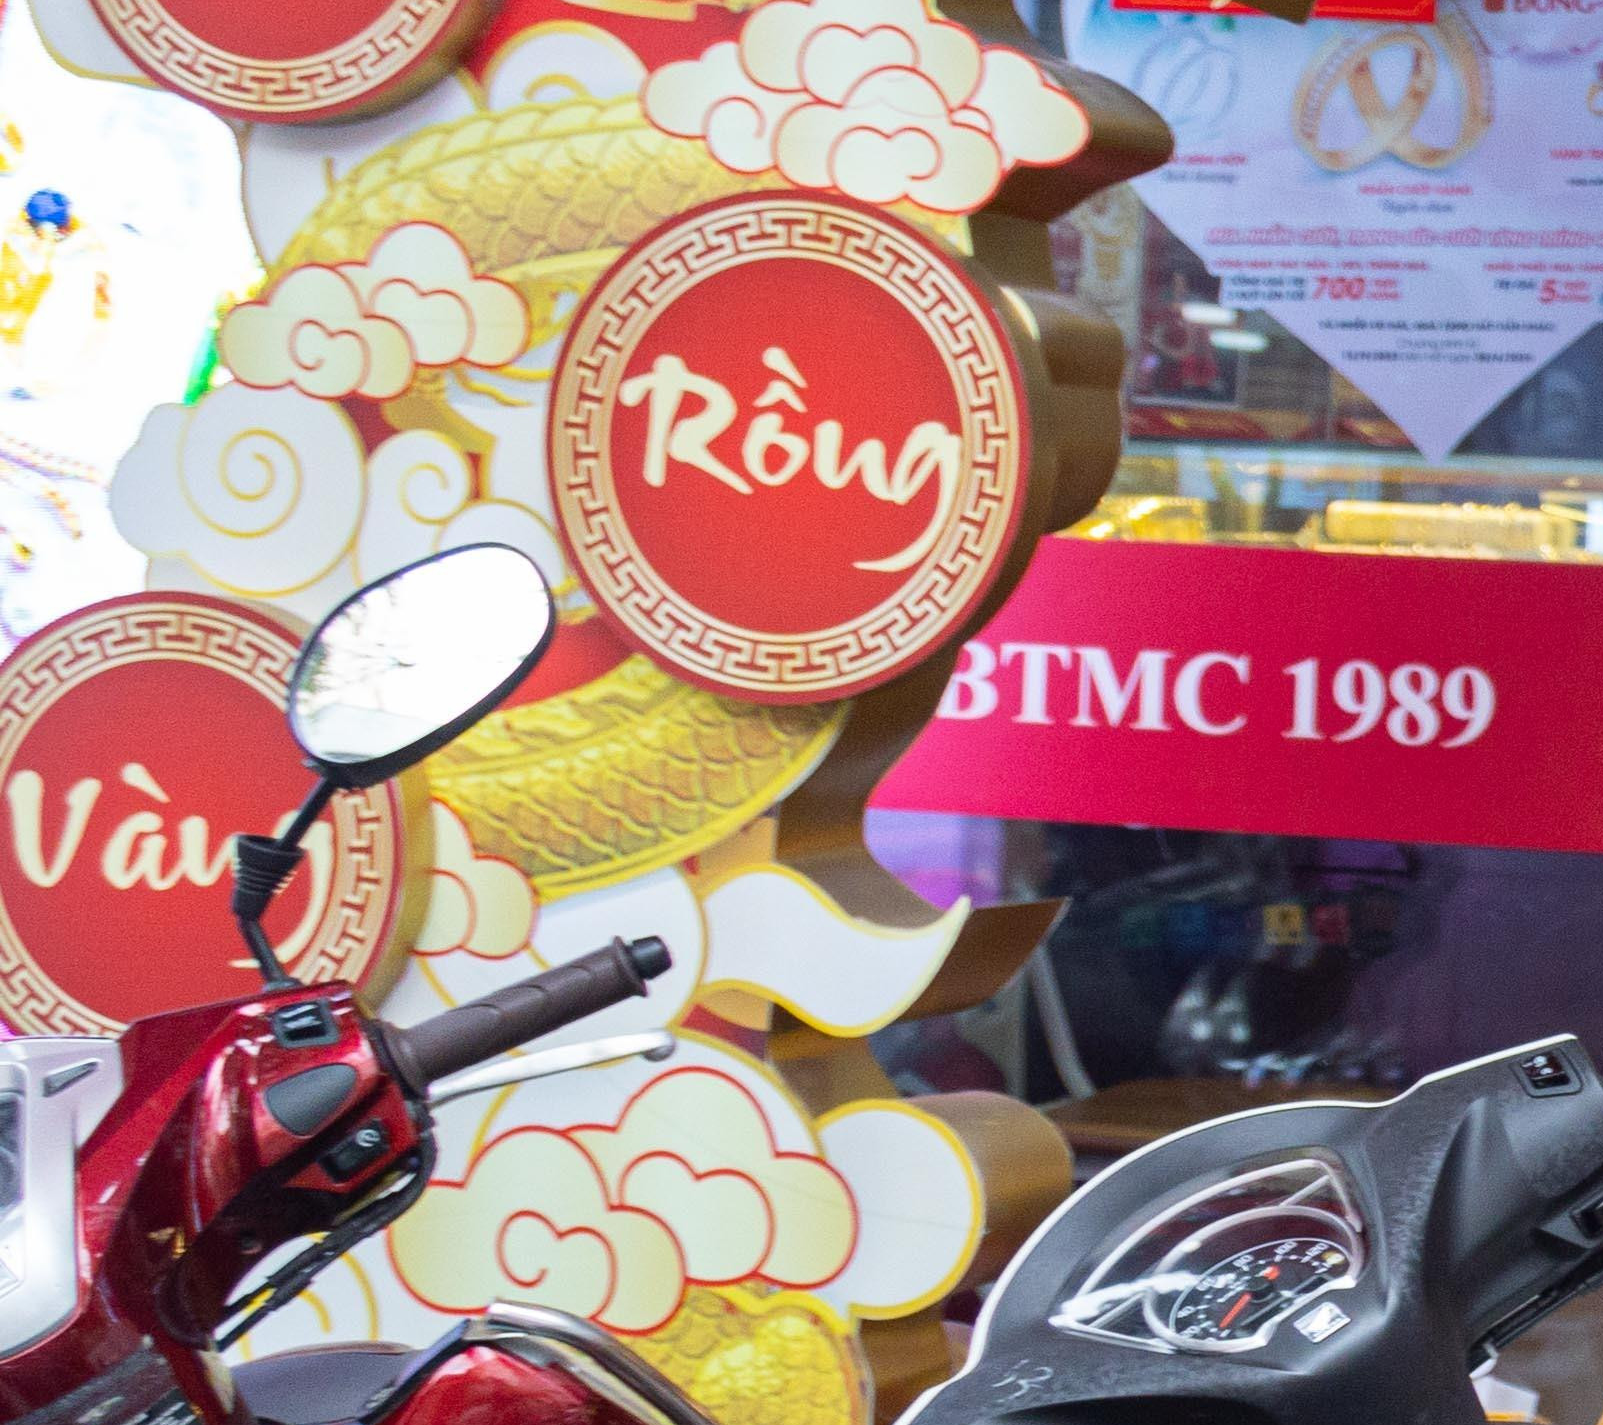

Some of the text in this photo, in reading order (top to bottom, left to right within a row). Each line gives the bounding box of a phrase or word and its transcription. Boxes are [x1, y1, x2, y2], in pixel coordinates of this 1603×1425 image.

[618, 346, 963, 573] Rồng
[934, 639, 1496, 747] BTMC 1989
